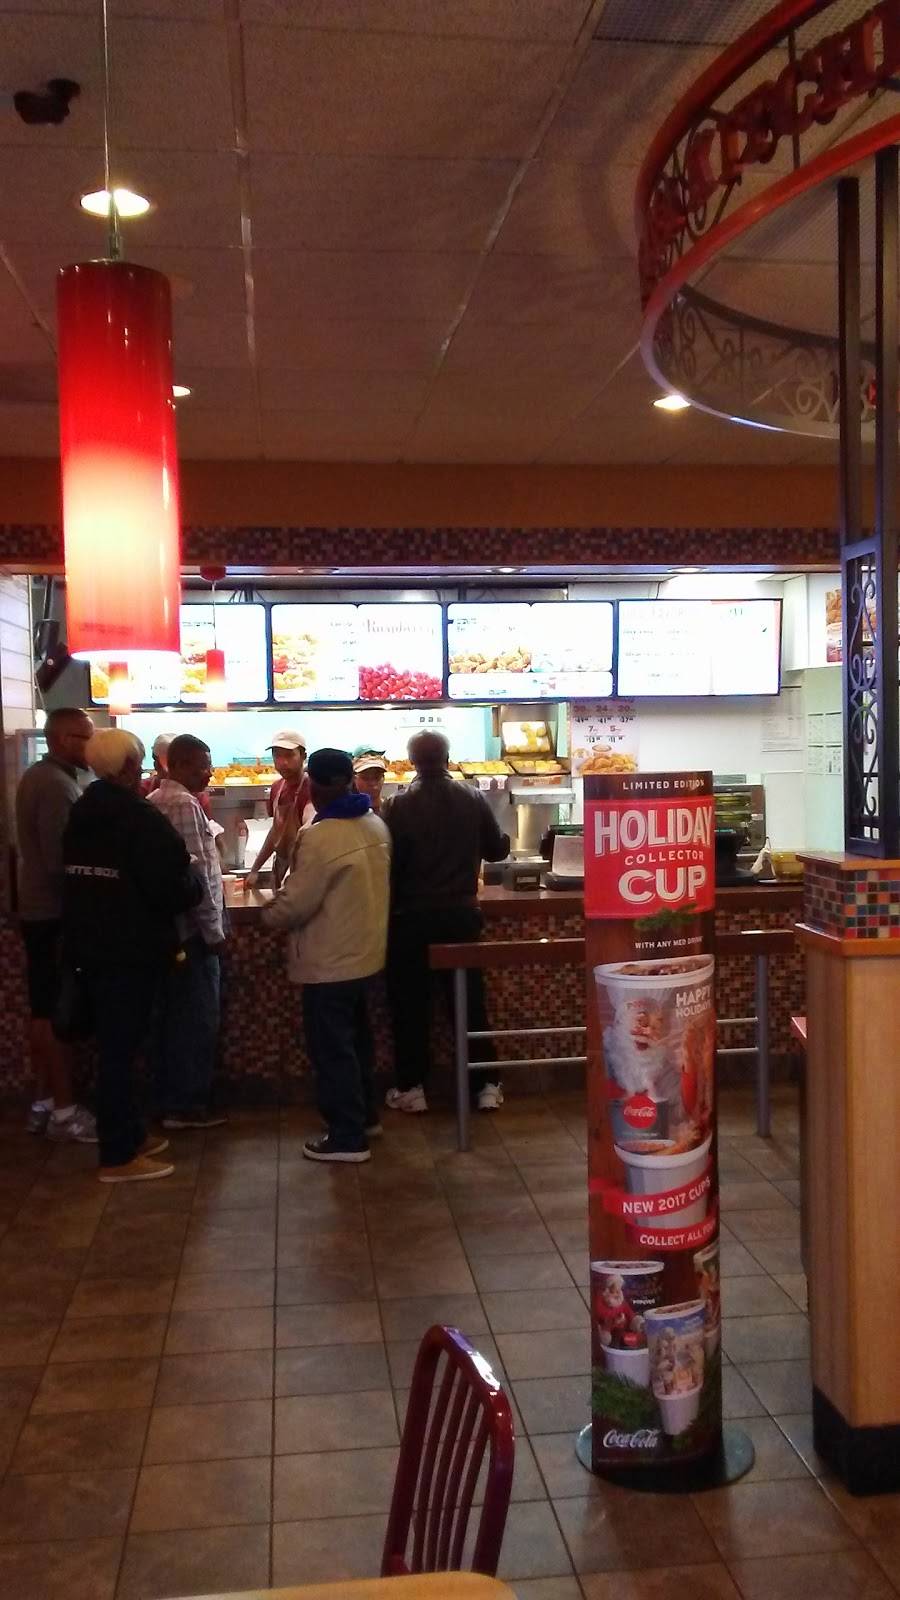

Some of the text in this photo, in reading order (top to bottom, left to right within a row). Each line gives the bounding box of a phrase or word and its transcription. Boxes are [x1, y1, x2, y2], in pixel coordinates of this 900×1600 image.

[622, 778, 705, 790] LIMITED EDITION
[594, 806, 713, 856] HOLIDAY
[624, 849, 705, 866] COLLECTOR
[618, 865, 707, 904] CUP
[656, 940, 672, 948] ANY
[676, 985, 712, 1008] HAPPY
[622, 1179, 711, 1214] NEW 2017 CUPS
[639, 1233, 685, 1246] COLLECT
[687, 1228, 703, 1242] ALL
